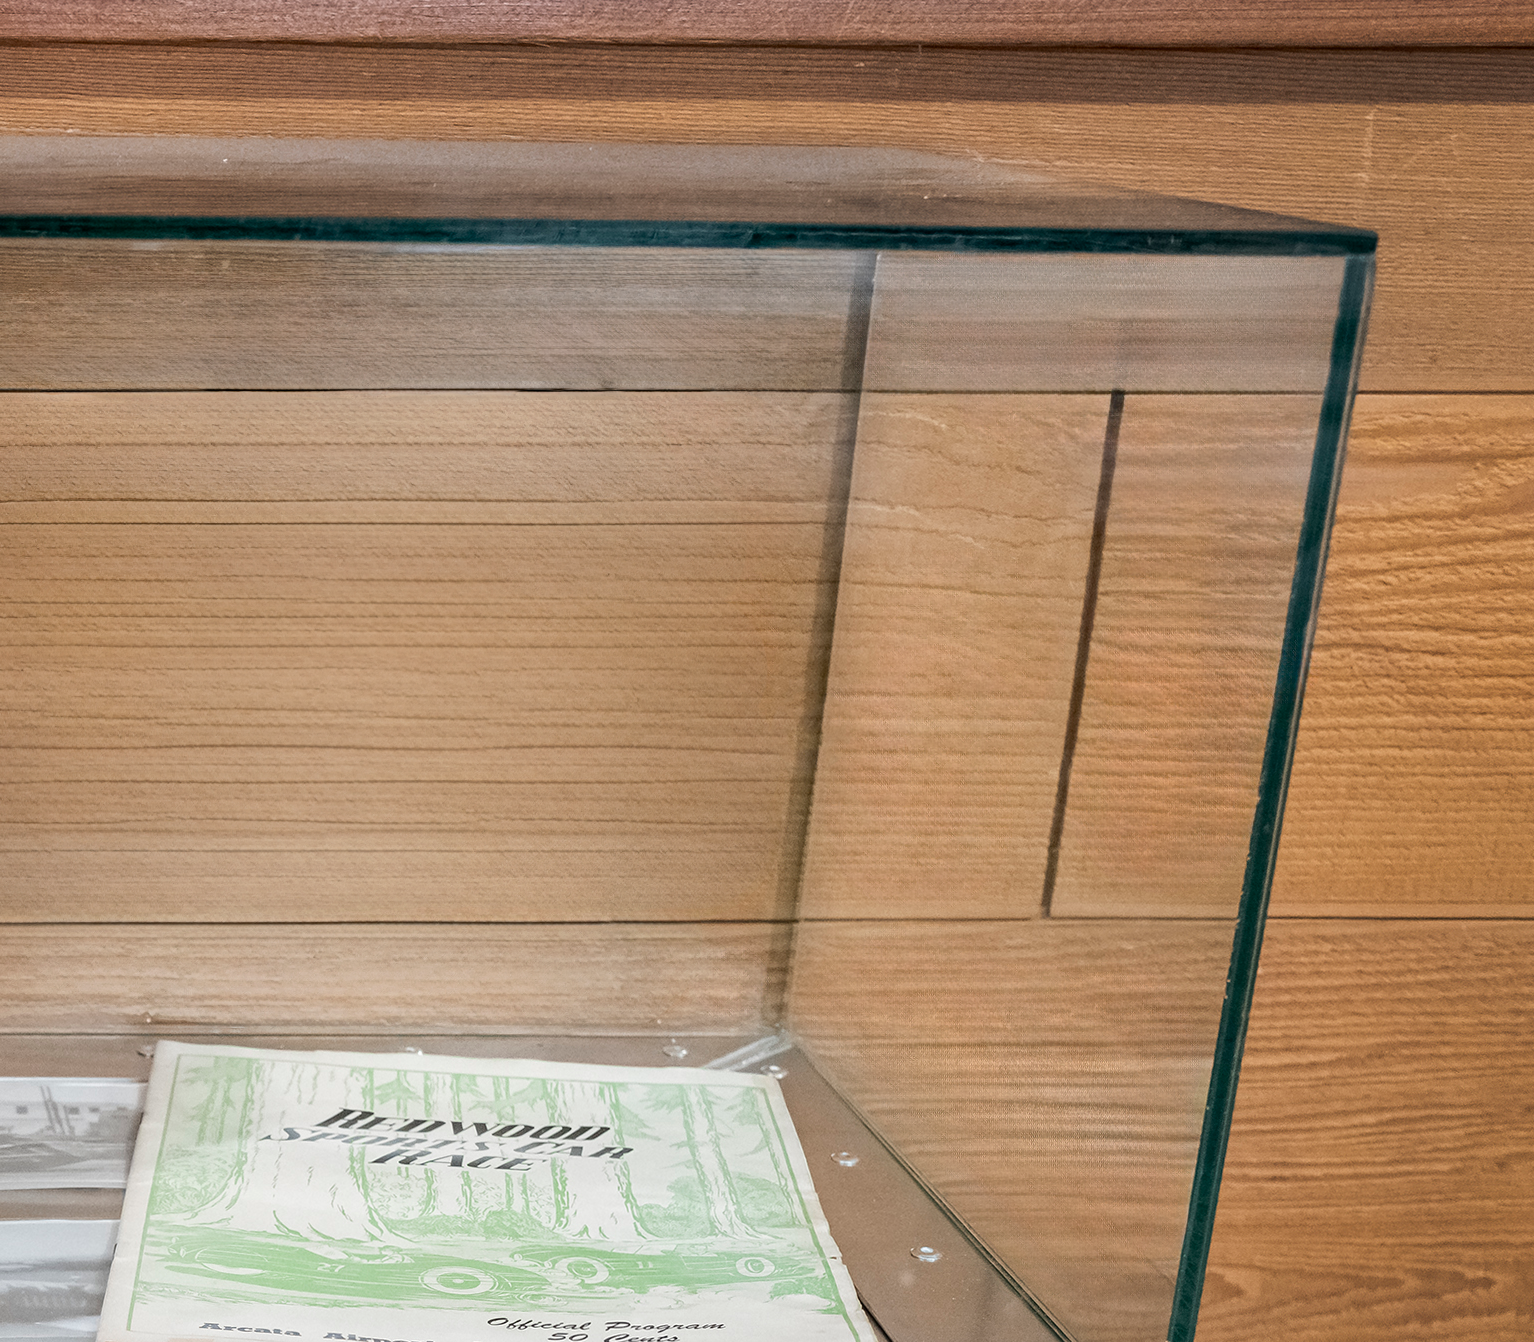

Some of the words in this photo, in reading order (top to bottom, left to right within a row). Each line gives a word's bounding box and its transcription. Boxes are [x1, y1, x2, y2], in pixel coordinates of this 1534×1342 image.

[308, 1107, 611, 1141] REDWOOD
[259, 1127, 506, 1152] SPORTS
[513, 1141, 634, 1159] CAR
[368, 1148, 547, 1172] RACE
[198, 1322, 302, 1337] Arcata
[486, 1317, 592, 1330] Official
[604, 1320, 726, 1333] Program
[547, 1332, 589, 1342] 50
